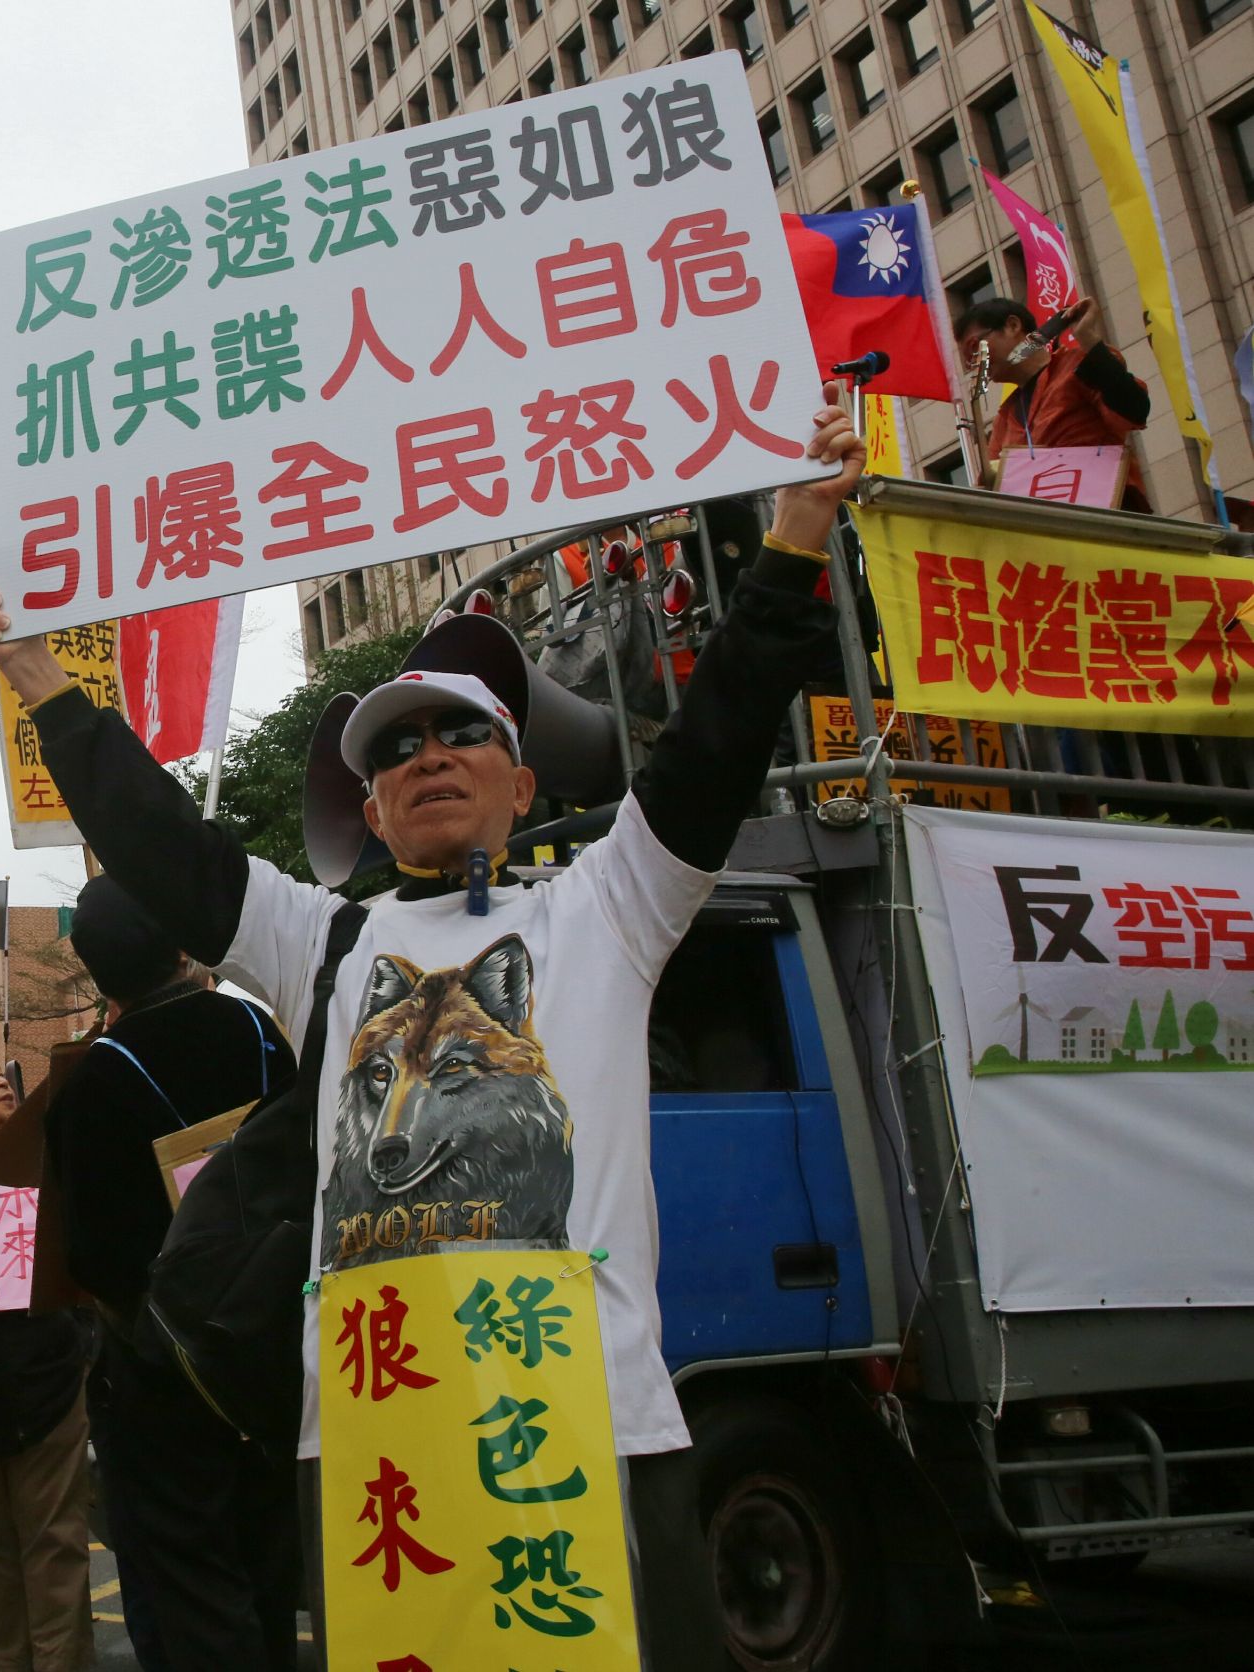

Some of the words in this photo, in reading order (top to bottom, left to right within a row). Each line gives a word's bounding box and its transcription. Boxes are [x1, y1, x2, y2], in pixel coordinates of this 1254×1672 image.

[16, 79, 732, 333] 反滲透法惡如狼
[15, 208, 761, 466] 抓共諜人人自危
[19, 354, 805, 609] 引爆全民怒火
[20, 773, 69, 808] 左
[993, 865, 1254, 971] 反空污
[334, 1200, 505, 1262] WOLF
[334, 1284, 457, 1672] 狼來
[454, 1274, 605, 1672] 綠色恐
